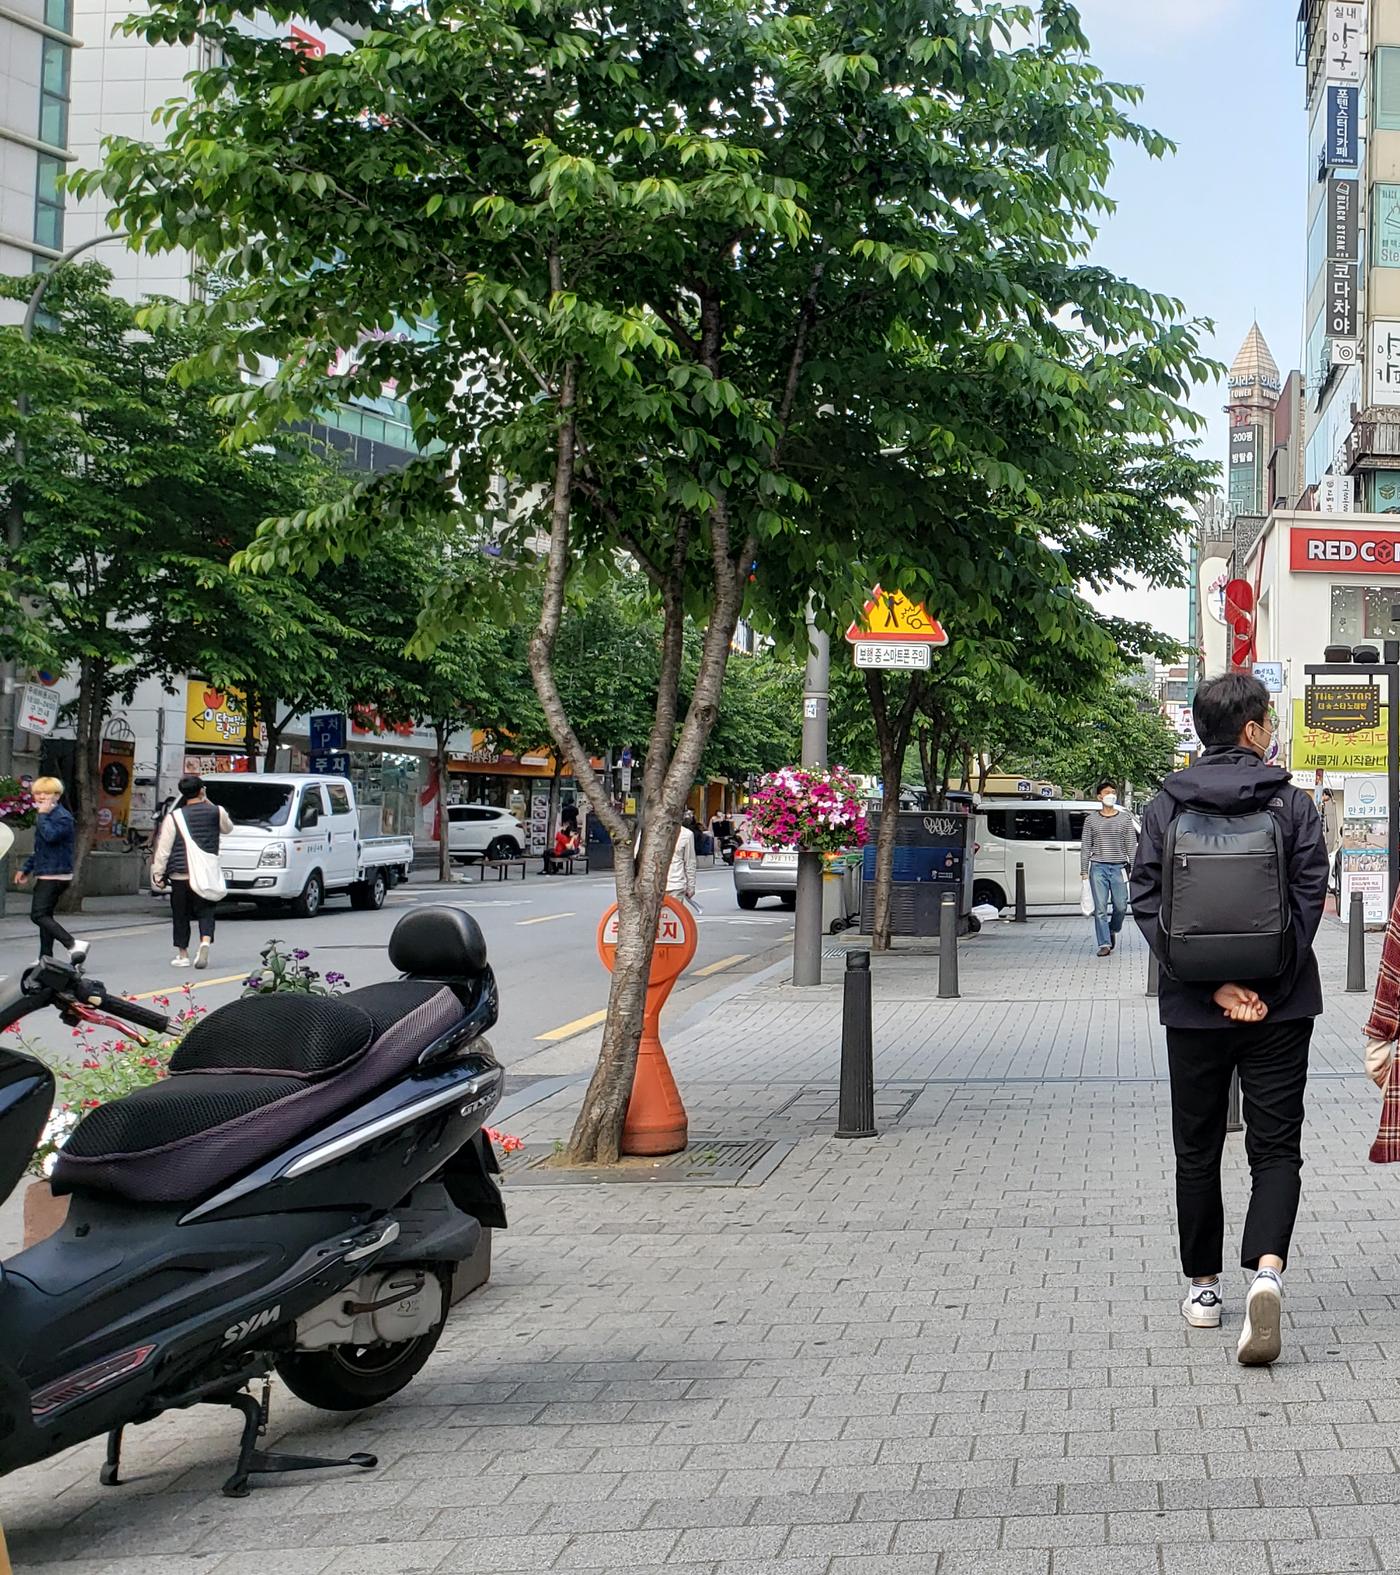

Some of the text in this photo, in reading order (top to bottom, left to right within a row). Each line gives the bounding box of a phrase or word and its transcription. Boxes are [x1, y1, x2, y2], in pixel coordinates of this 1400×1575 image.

[1334, 7, 1357, 19] 실내
[1336, 89, 1349, 158] 포텐스터디카페
[1336, 195, 1346, 221] BLACK
[1336, 225, 1346, 250] STEAK
[1333, 265, 1351, 335] 코다차야
[1231, 388, 1252, 399] TOWER
[1232, 432, 1253, 443] 200평
[1231, 452, 1253, 463] 방탈출
[1308, 540, 1357, 561] RED
[883, 649, 910, 664] 스마트폰
[912, 650, 926, 664] 주의
[1345, 692, 1372, 701] STAR
[321, 734, 331, 748] P
[1304, 754, 1339, 766] 새롭게
[220, 1304, 281, 1349] SYM
